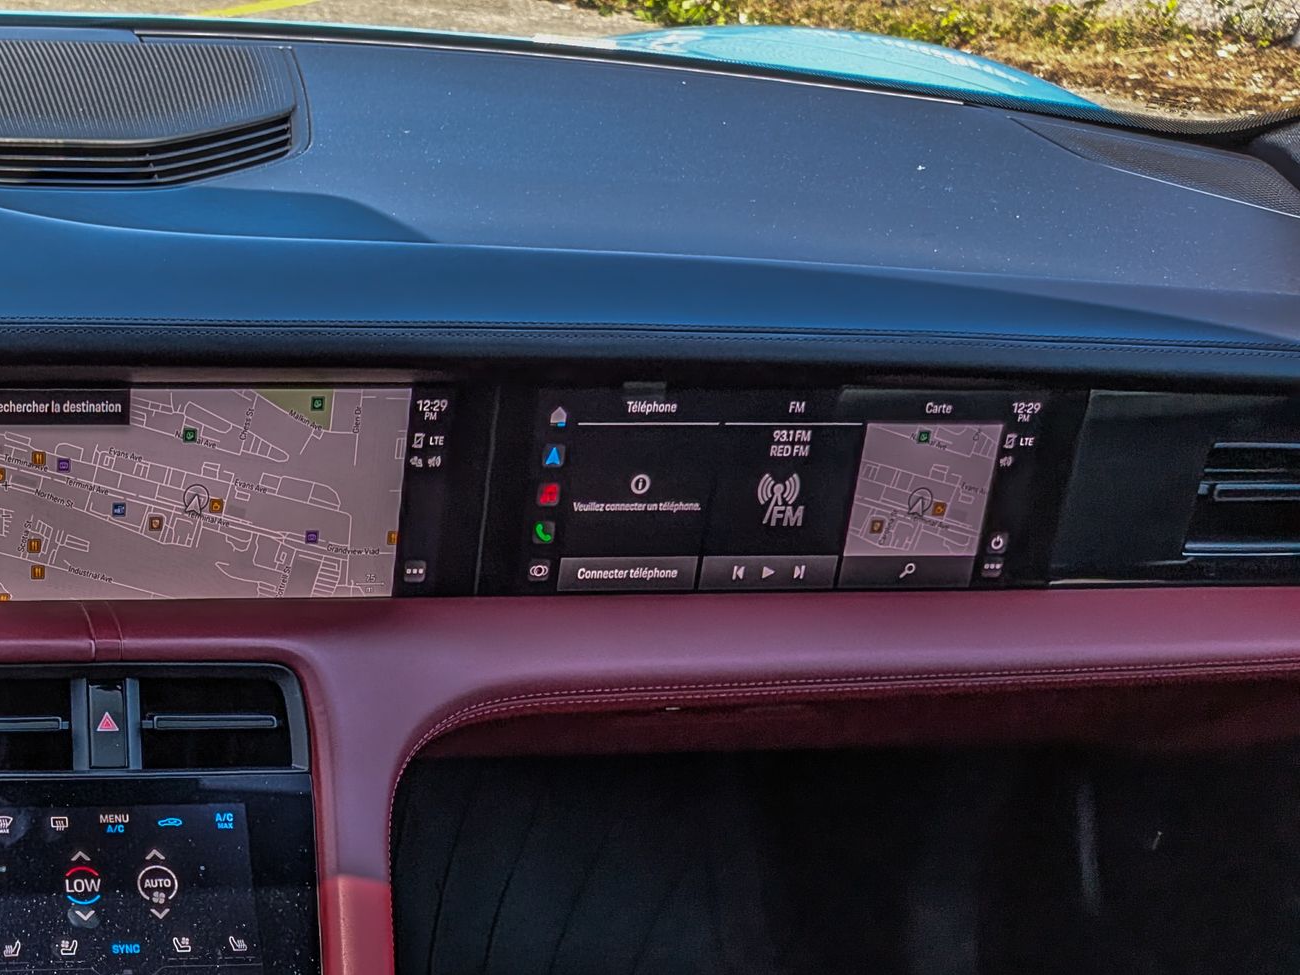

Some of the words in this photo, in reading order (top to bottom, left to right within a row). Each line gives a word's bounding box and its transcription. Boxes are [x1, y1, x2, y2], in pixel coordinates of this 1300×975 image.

[51, 400, 61, 413] la
[62, 400, 122, 413] destination
[355, 405, 362, 416] Dr
[416, 399, 448, 412] 12:29
[627, 400, 678, 415] Téléphone
[789, 402, 805, 413] FM
[926, 402, 953, 414] Carte
[1012, 402, 1041, 414] 12:29
[245, 407, 255, 420] St
[425, 412, 438, 421] PM
[1017, 413, 1030, 422] PM
[289, 409, 309, 427] Malkin
[308, 418, 323, 431] Ave
[353, 417, 362, 434] Glen
[240, 417, 251, 441] Chess
[429, 436, 444, 446] LTE
[773, 430, 793, 442] 93.1
[794, 430, 812, 442] FM
[1019, 437, 1035, 447] LTE
[202, 438, 218, 449] Ave
[108, 447, 127, 460] Evans
[127, 452, 143, 462] Ave
[770, 445, 791, 457] RED
[792, 445, 810, 457] FM
[4, 454, 35, 468] Terminal
[65, 477, 95, 493] Terminal
[94, 486, 109, 496] Ave
[234, 478, 252, 490] Evans
[252, 483, 268, 494] Ave
[34, 488, 62, 506] Northern
[62, 498, 74, 508] St
[573, 501, 604, 512] Veuillez
[605, 502, 646, 512] connecter
[646, 503, 658, 512] un
[770, 505, 804, 527] FM
[23, 519, 33, 530] St
[216, 518, 230, 528] Ave
[17, 528, 31, 553] Scotia
[326, 544, 362, 555] Grandview
[362, 547, 380, 555] Viad
[68, 565, 100, 581] Industrial
[100, 575, 113, 584] Ave
[365, 574, 376, 583] 75
[577, 567, 628, 580] Connecter
[629, 566, 678, 582] téléphone
[100, 813, 130, 824] MENU
[215, 813, 234, 823] A/C
[106, 823, 125, 834] A/C
[65, 878, 101, 893] LOW
[143, 878, 172, 889] AUTO
[111, 943, 141, 954] SYNC
